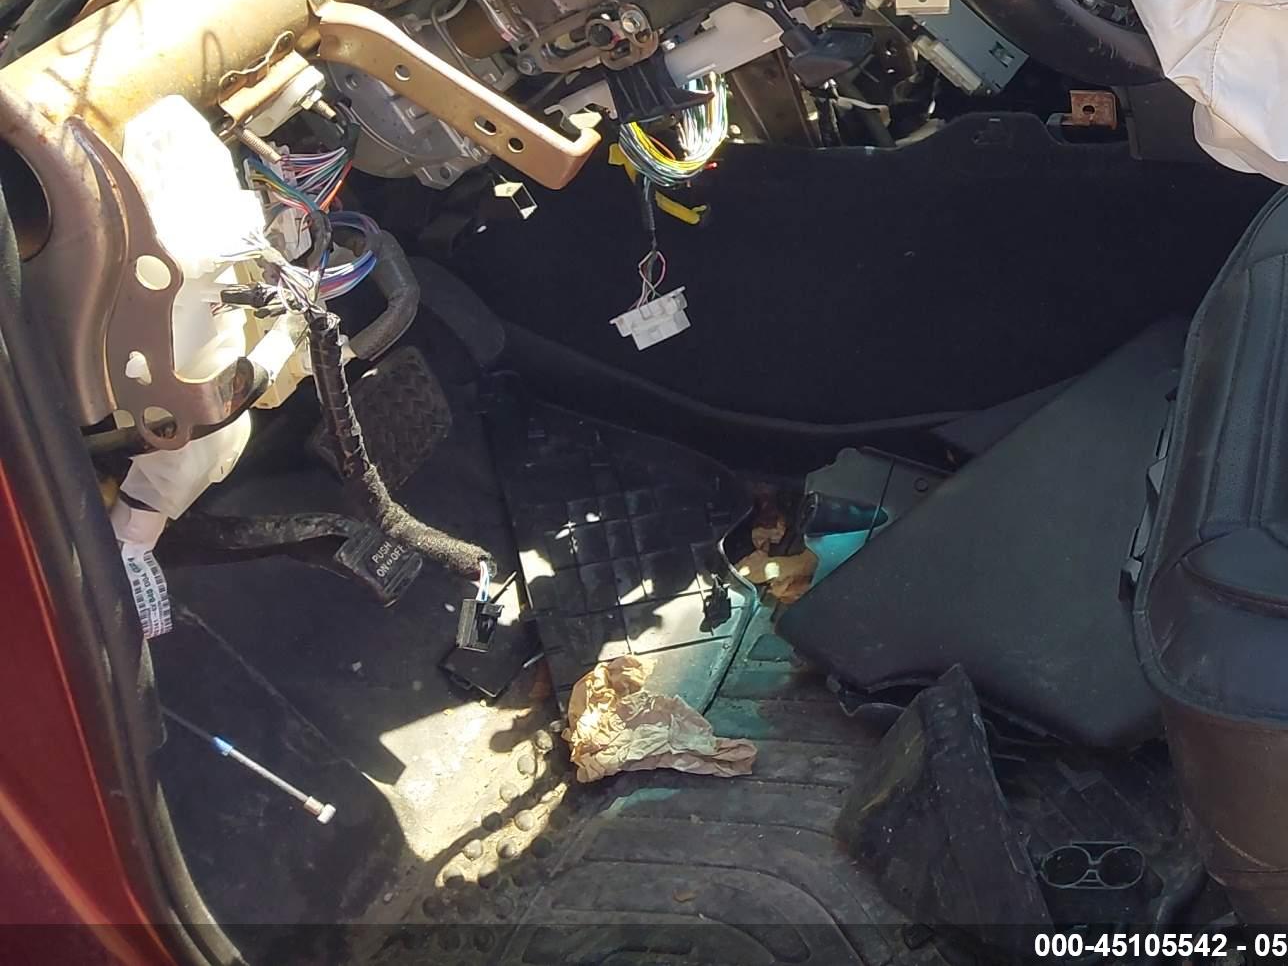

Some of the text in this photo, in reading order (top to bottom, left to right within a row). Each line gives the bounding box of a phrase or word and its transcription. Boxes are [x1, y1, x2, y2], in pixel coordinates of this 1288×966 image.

[371, 540, 392, 564] PUSH
[376, 544, 406, 578] ON OFF
